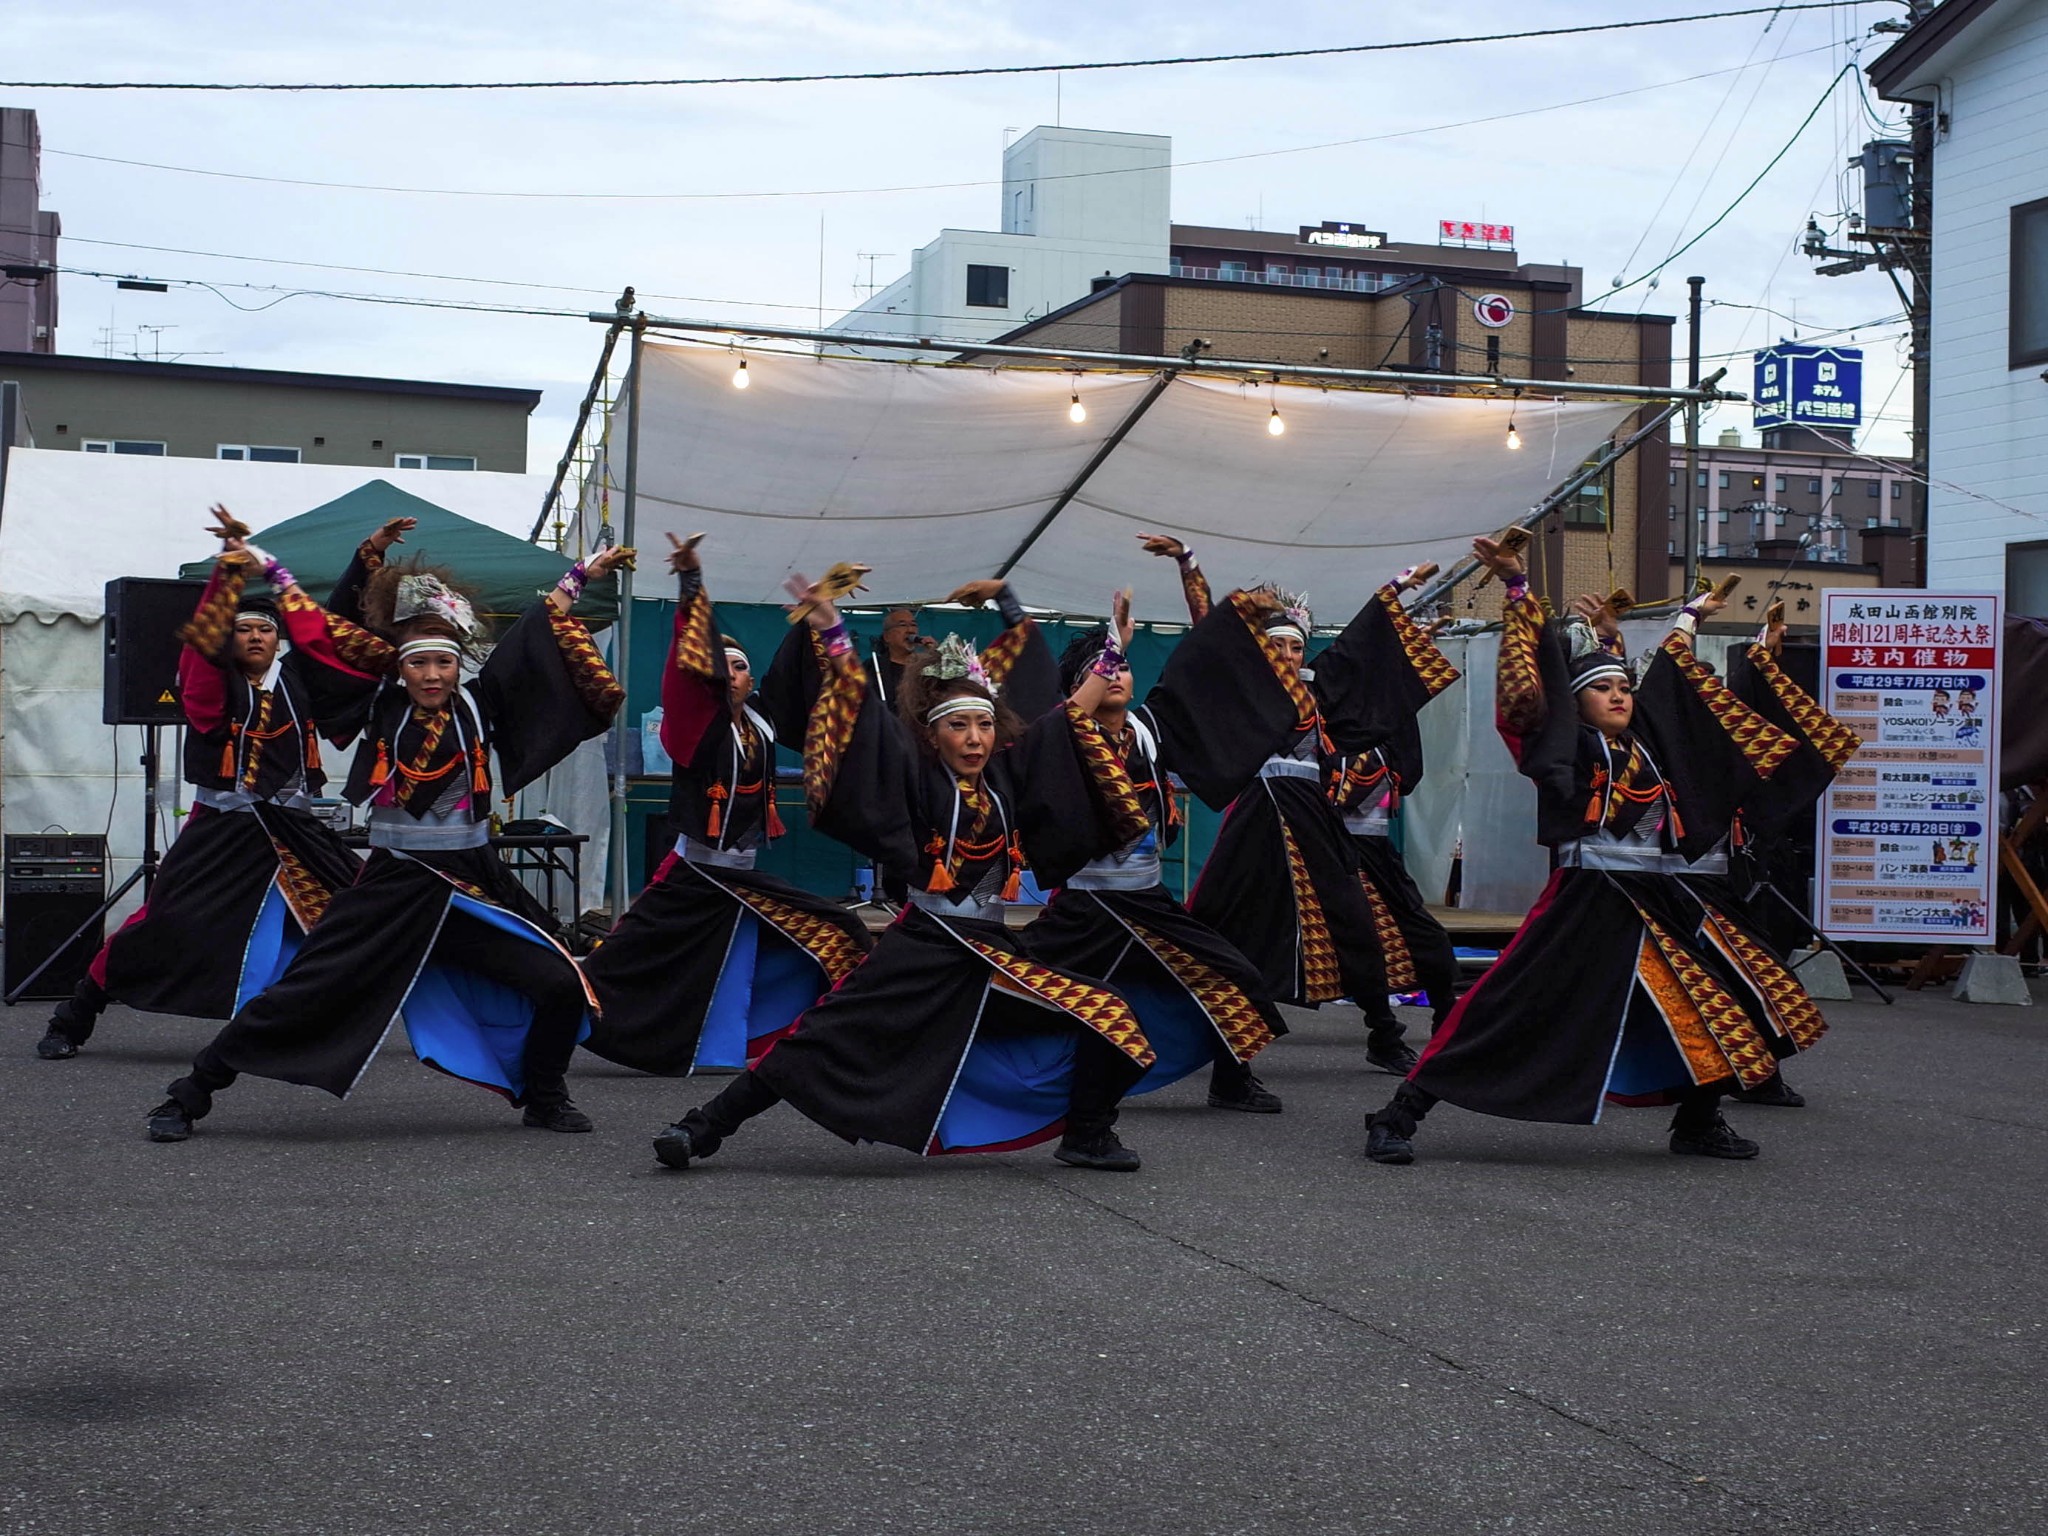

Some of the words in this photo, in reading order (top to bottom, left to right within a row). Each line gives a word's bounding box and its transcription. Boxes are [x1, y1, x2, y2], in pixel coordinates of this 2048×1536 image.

[1812, 384, 1843, 398] ホテル
[1848, 603, 1977, 620] 成田山函館別院
[1831, 623, 1992, 645] 開創121周年記念大祭
[1851, 647, 1970, 667] 境内催物
[1851, 675, 1970, 688] 平成29年7月27日(木)
[1847, 821, 1967, 834] 平成29年7月28日(金)
